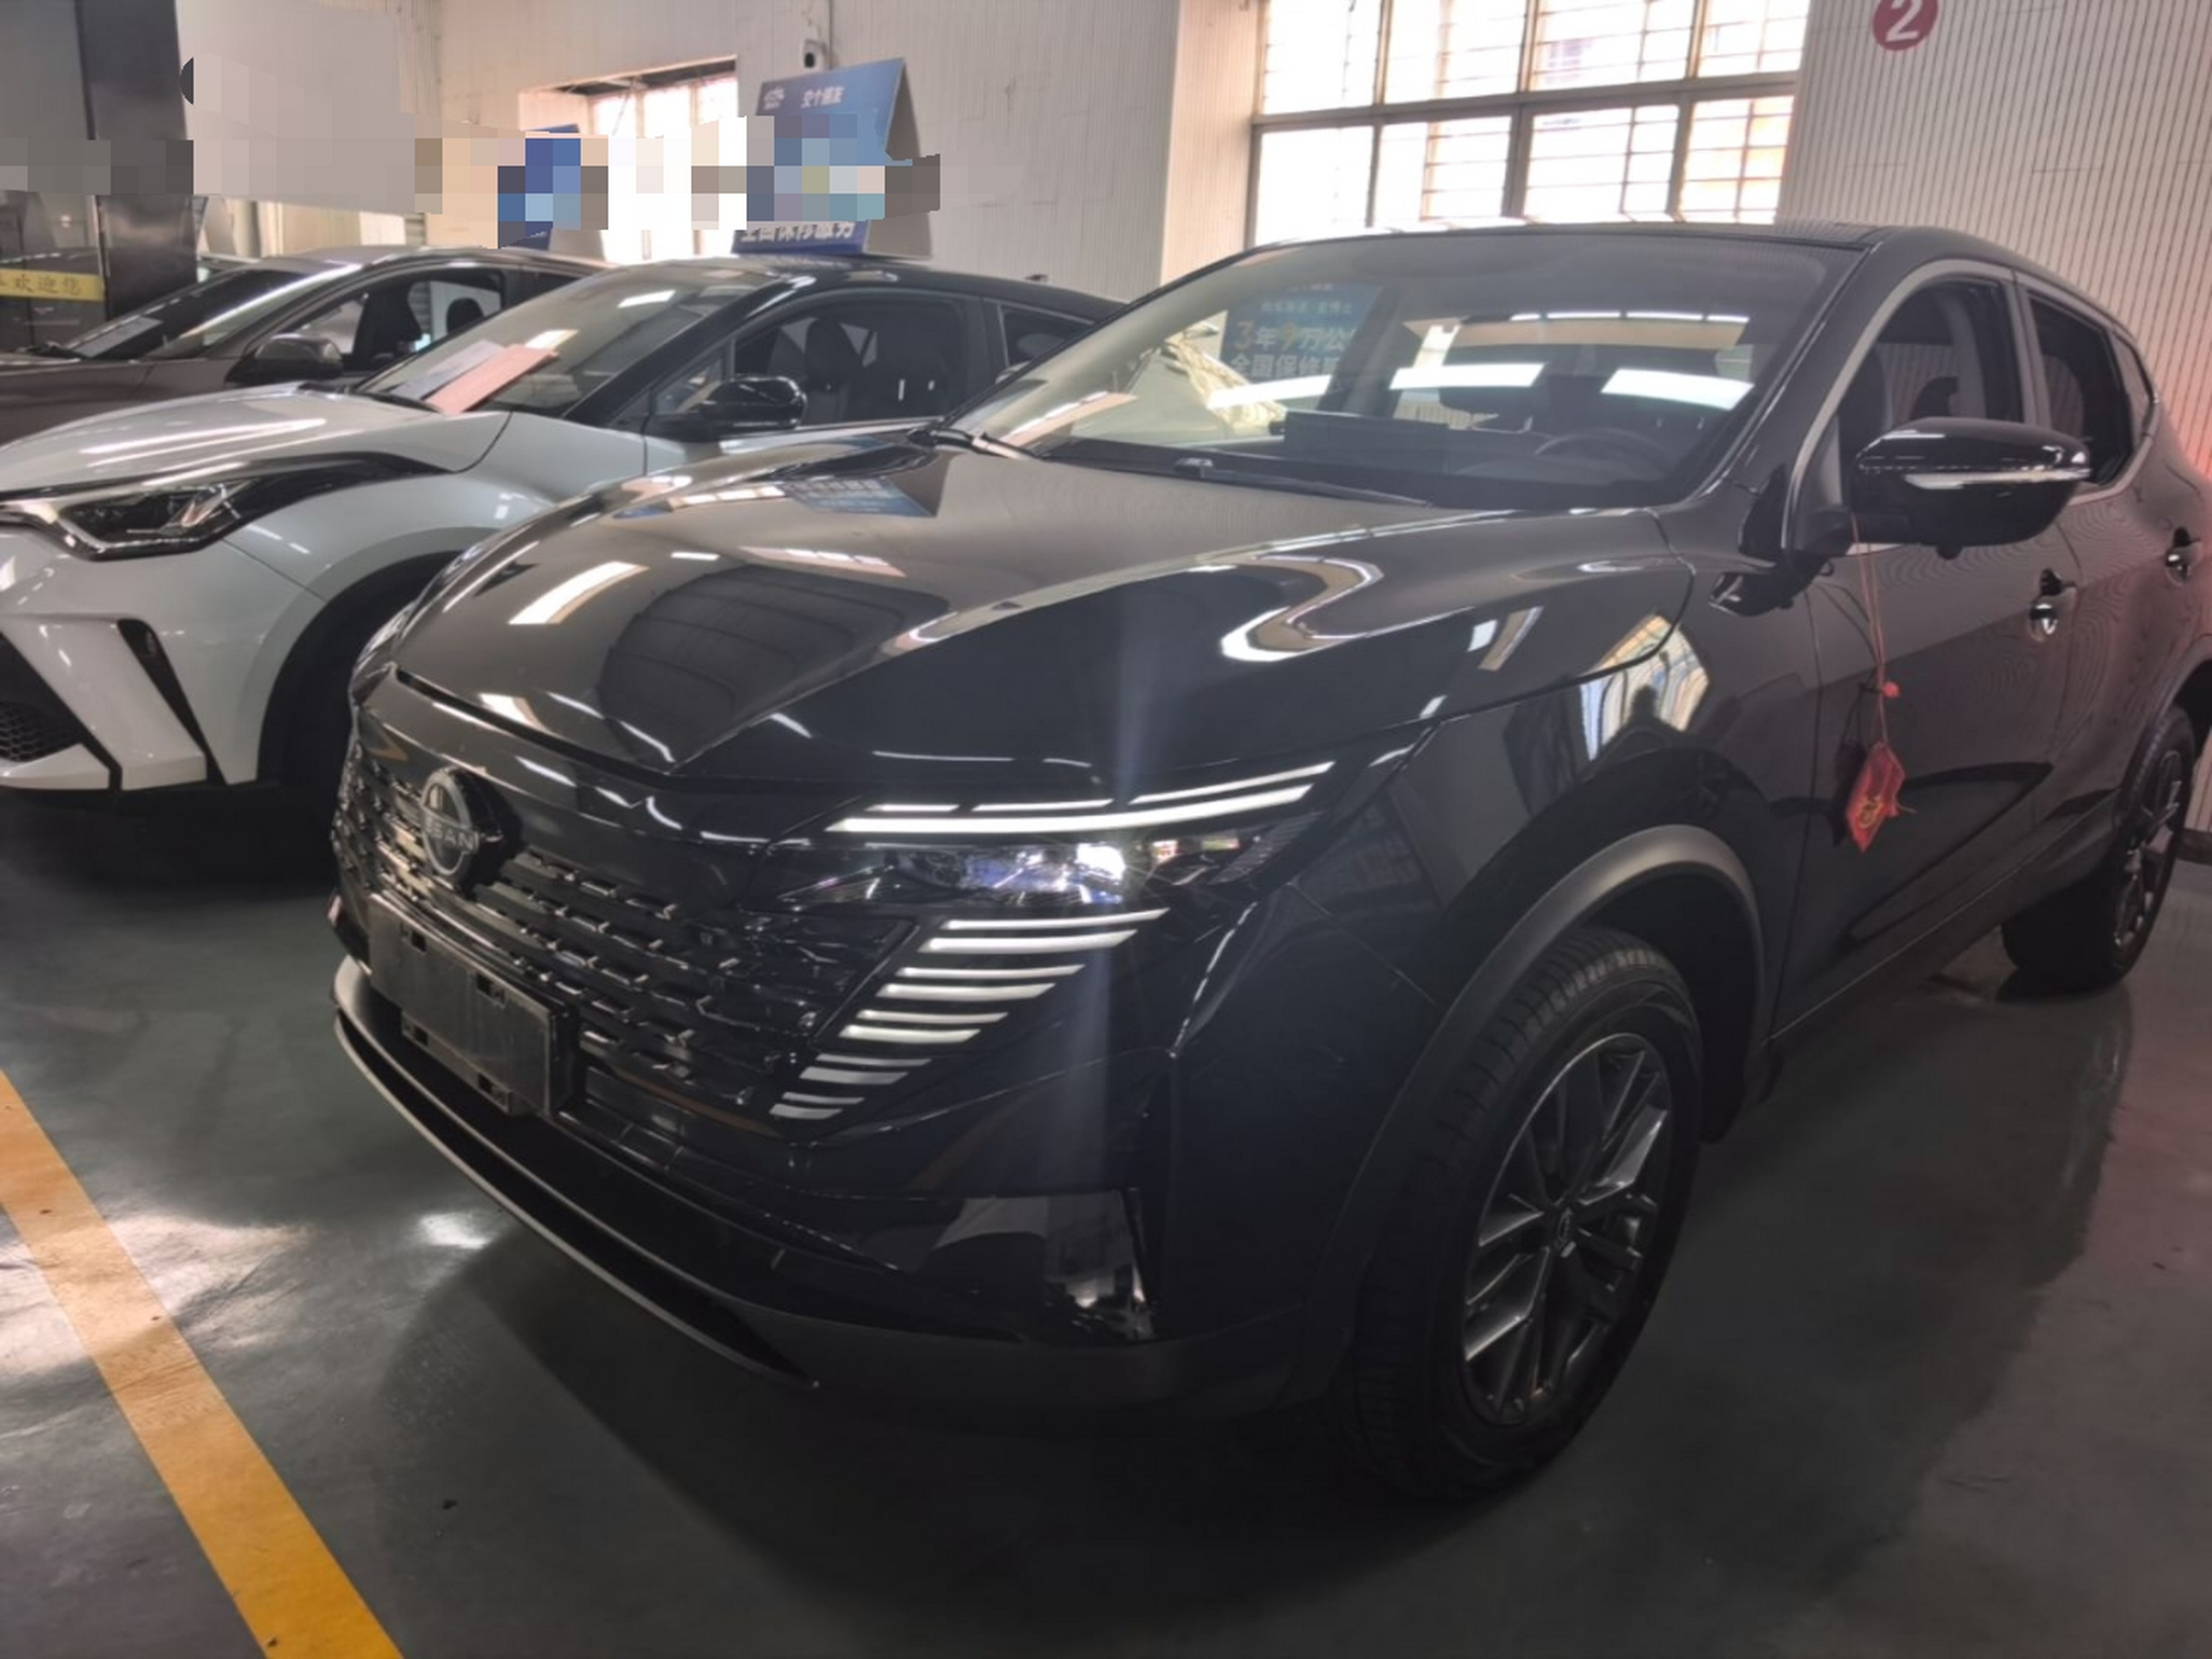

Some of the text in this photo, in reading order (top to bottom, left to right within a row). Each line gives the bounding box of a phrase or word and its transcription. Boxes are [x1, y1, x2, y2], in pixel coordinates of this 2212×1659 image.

[1886, 0, 1923, 41] 2
[1234, 320, 1355, 352] 3年9万公
